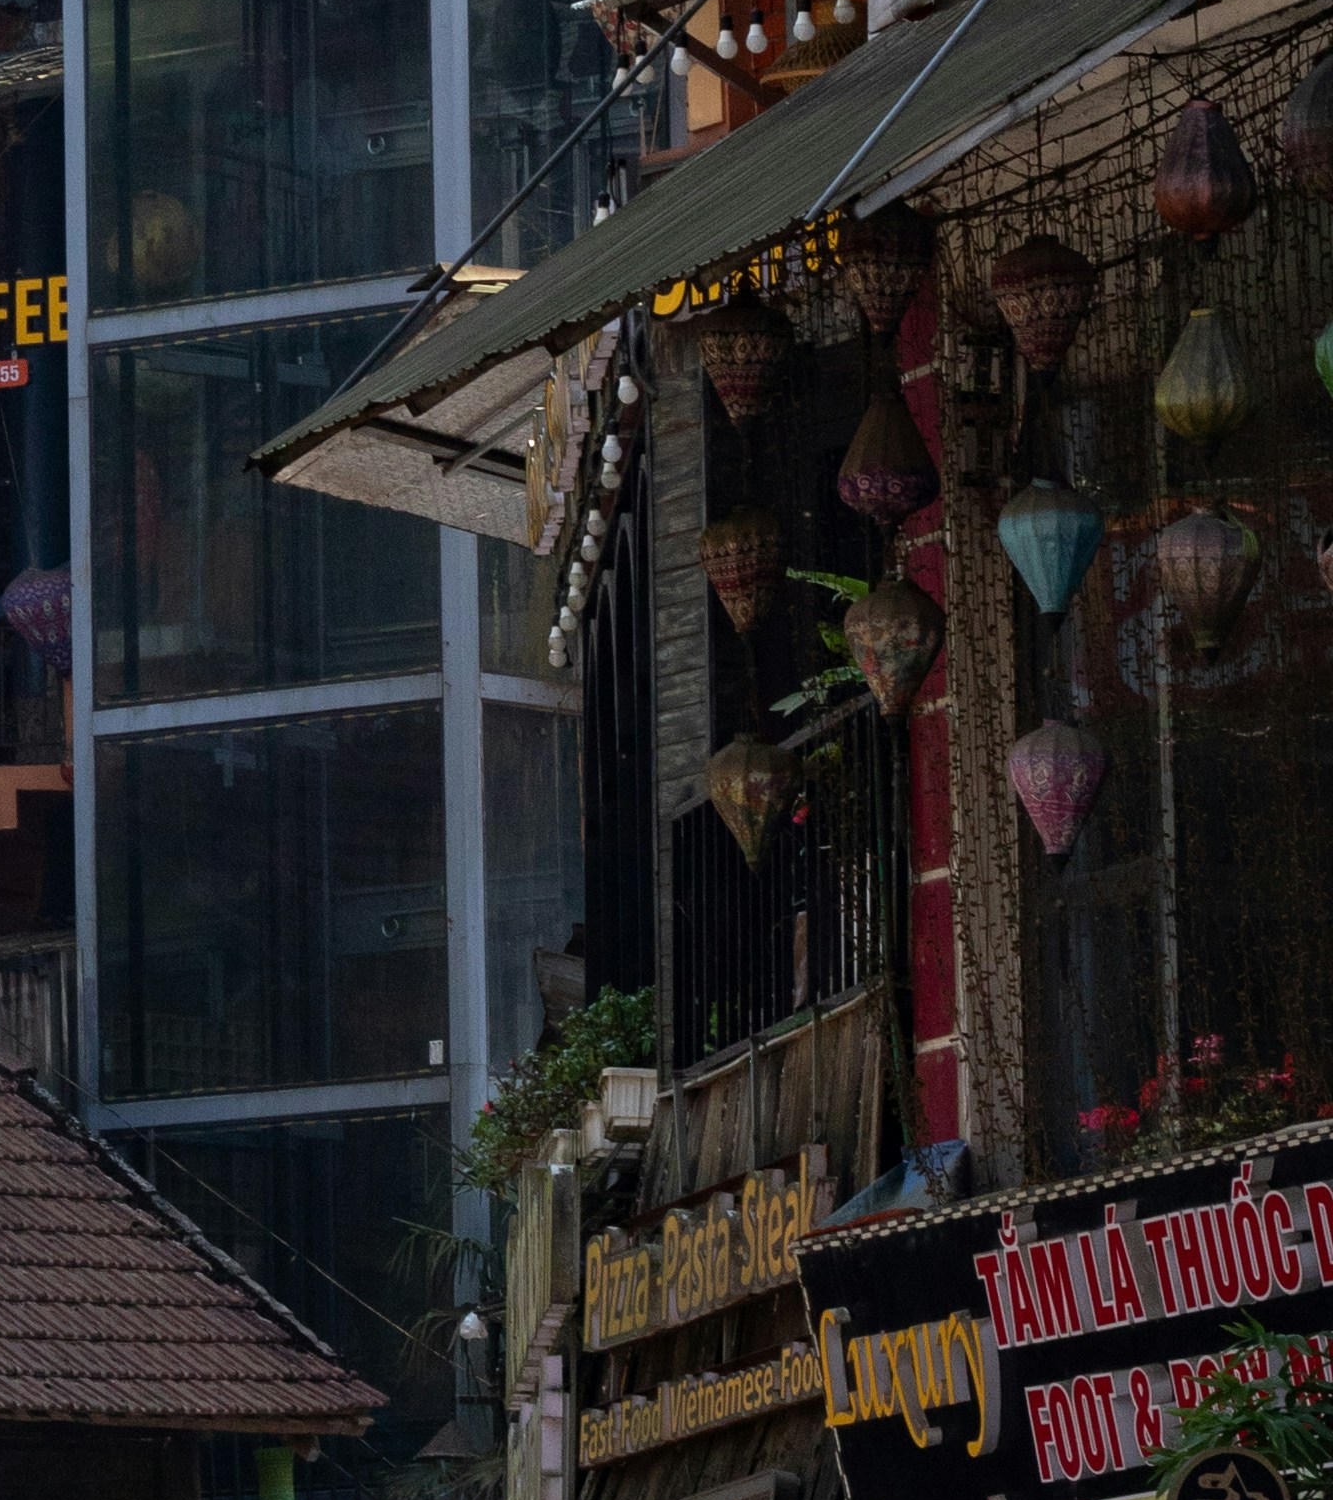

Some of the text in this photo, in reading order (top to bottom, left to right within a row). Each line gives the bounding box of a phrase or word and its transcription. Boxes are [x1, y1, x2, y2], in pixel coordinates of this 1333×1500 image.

[583, 1231, 651, 1350] Pizza
[973, 1212, 1082, 1349] TẮM
[1077, 1203, 1147, 1331] LÁ
[1142, 1160, 1305, 1319] THUỐC
[579, 1410, 615, 1463] Fast
[620, 1384, 662, 1448] Food
[668, 1361, 774, 1434] Vietnamese
[820, 1308, 991, 1458] Luxury
[1026, 1367, 1165, 1483] FOOT &
